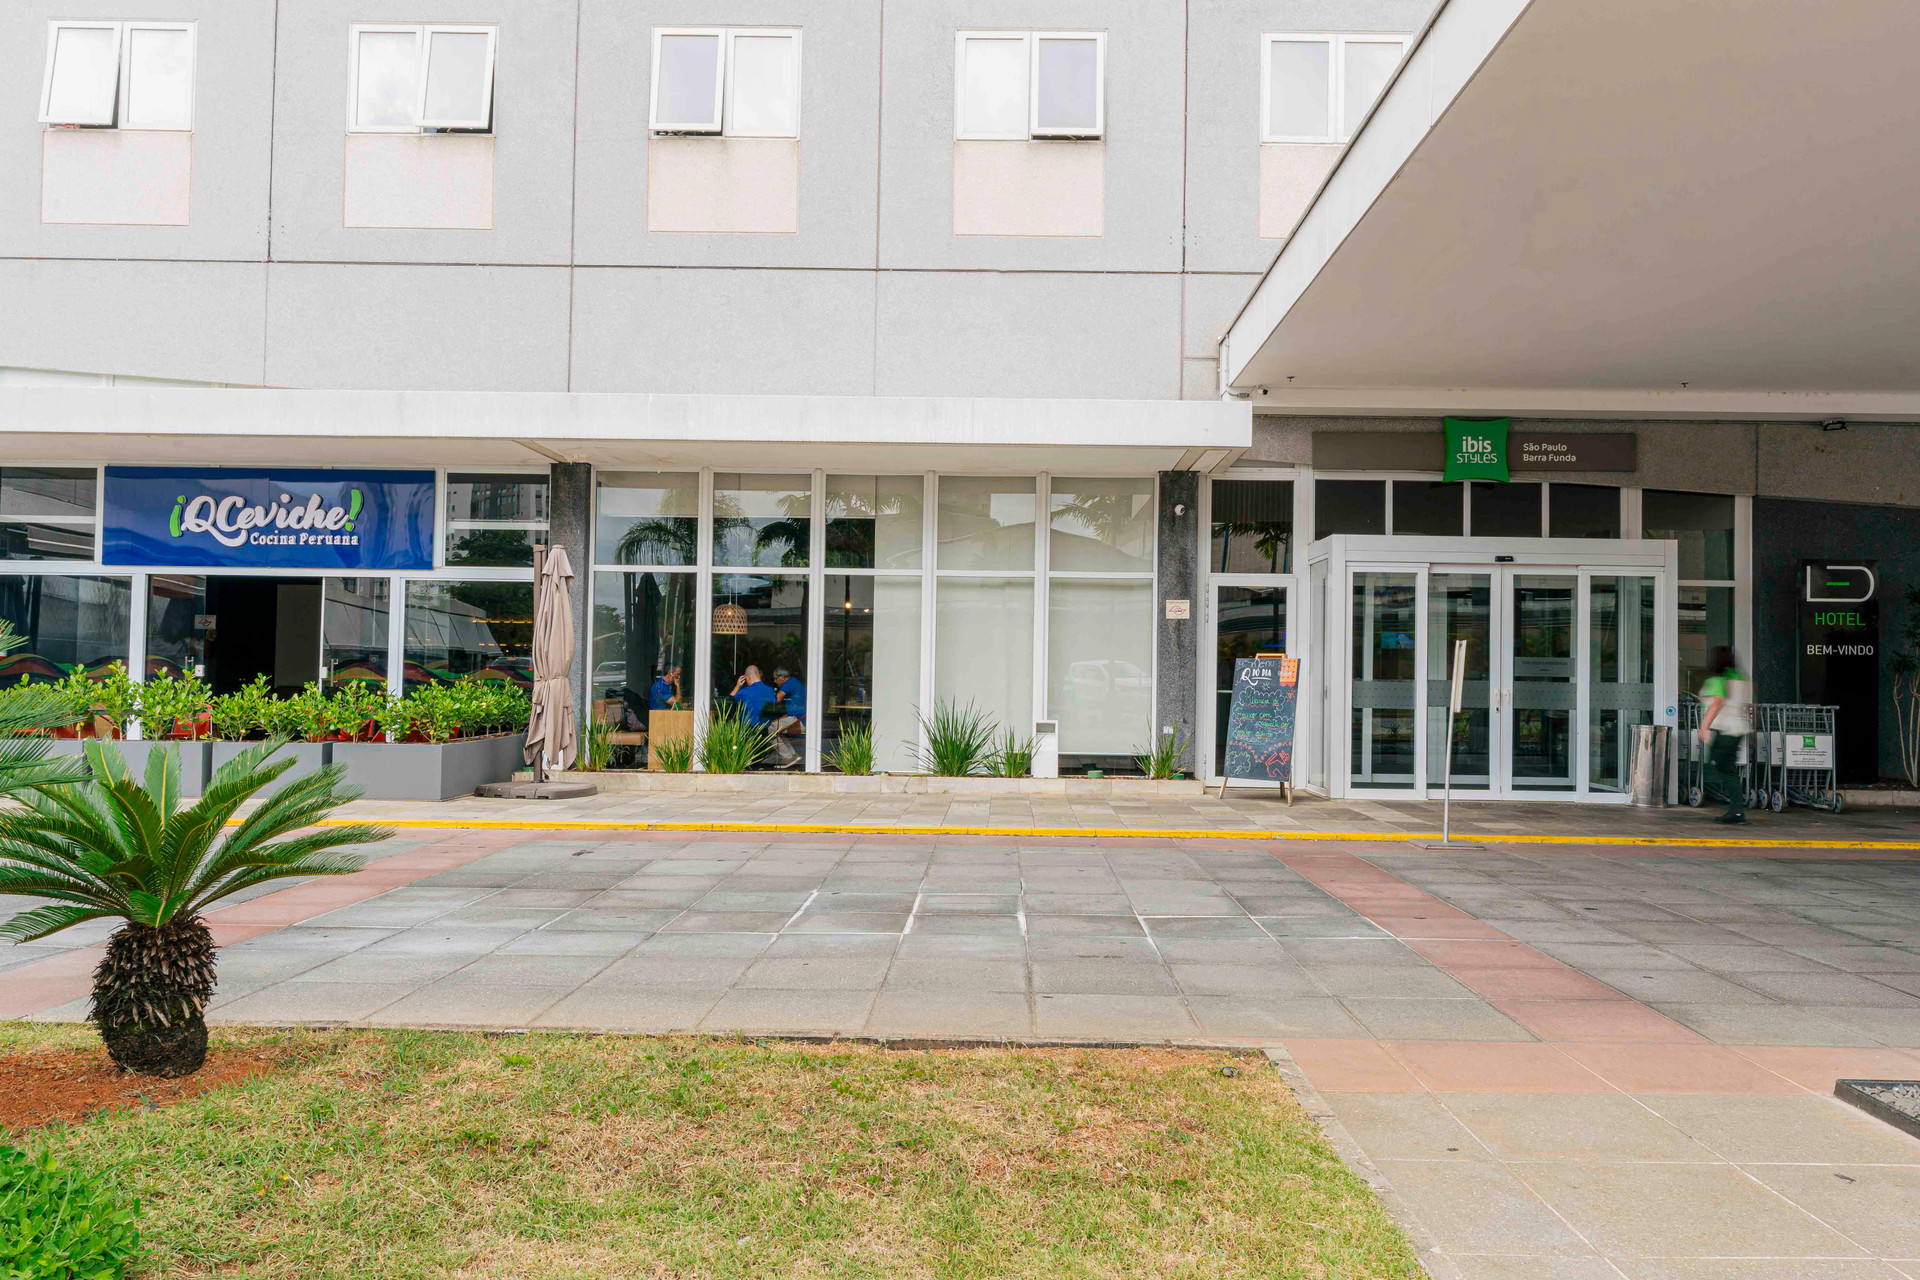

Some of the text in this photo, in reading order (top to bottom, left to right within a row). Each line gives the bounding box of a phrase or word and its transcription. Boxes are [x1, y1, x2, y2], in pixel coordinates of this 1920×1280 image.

[1462, 436, 1492, 452] ibis
[1523, 443, 1567, 451] São Paulo
[1523, 454, 1577, 462] Barra Funda
[250, 530, 359, 546] Cocina Peruana
[1814, 612, 1866, 626] HOTEL
[1806, 644, 1874, 655] BEM-VINDO
